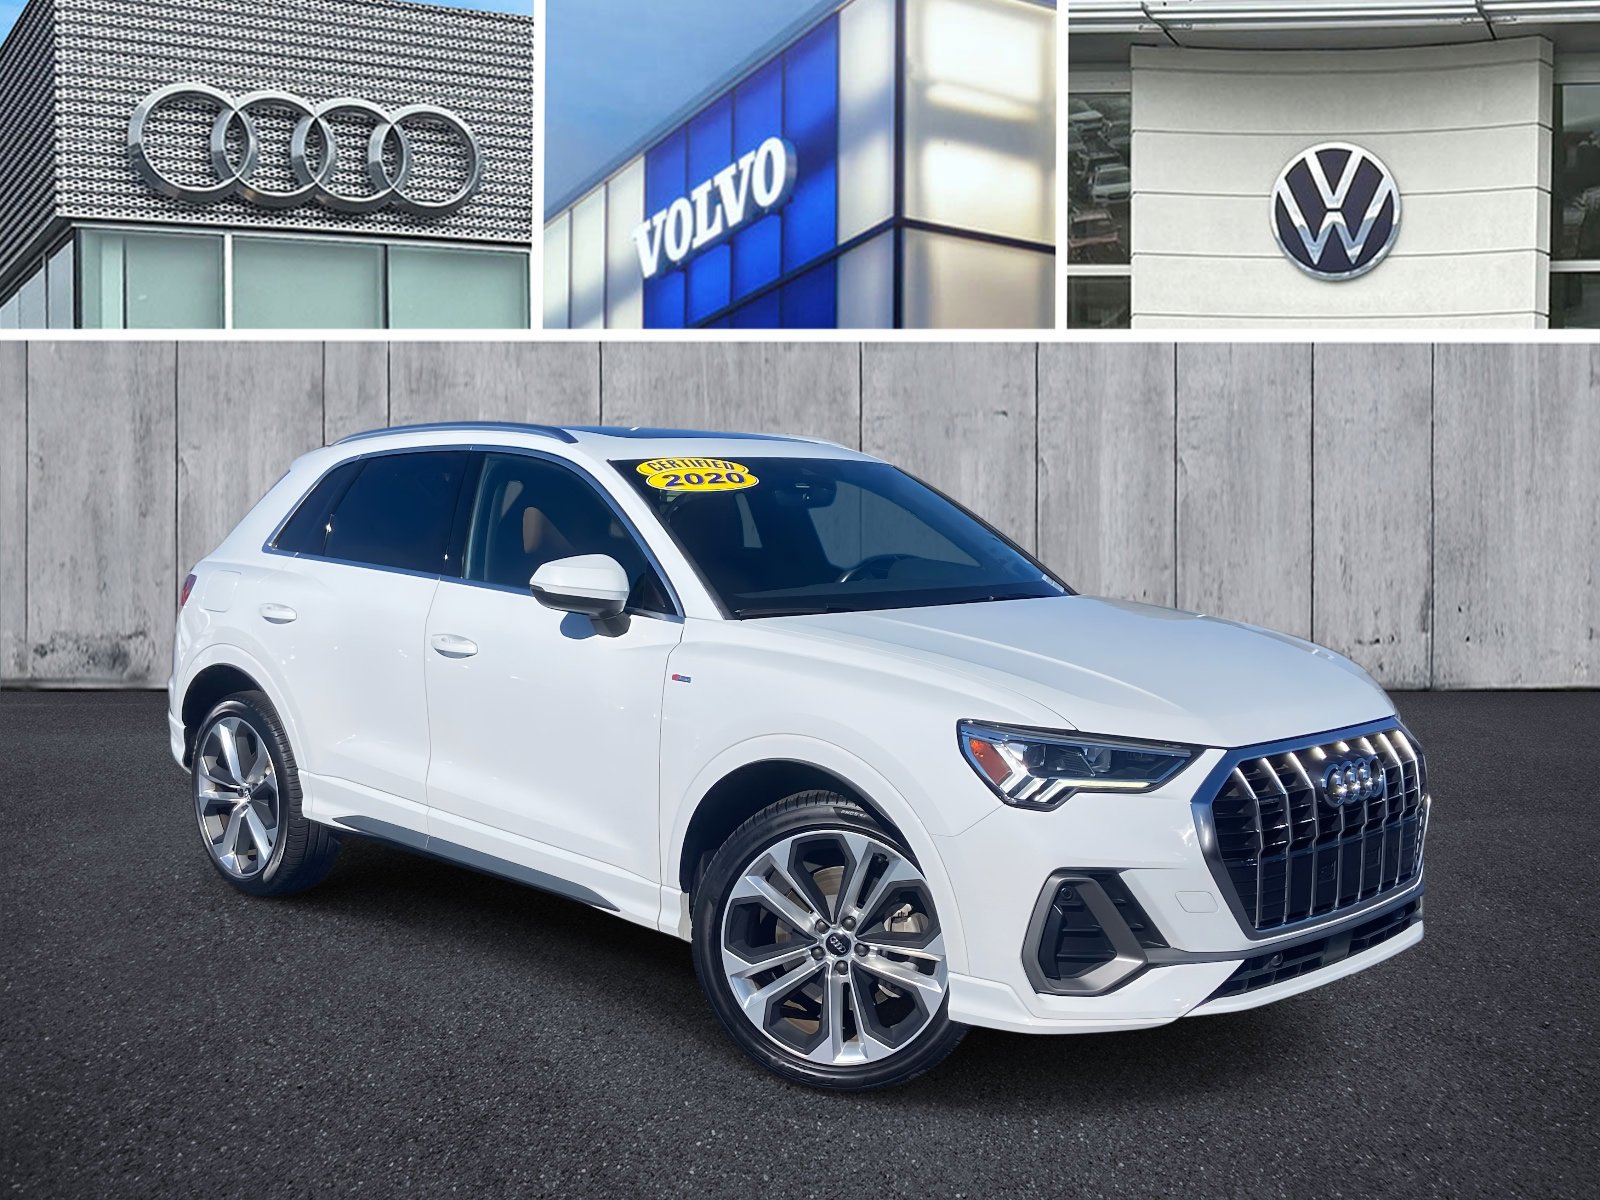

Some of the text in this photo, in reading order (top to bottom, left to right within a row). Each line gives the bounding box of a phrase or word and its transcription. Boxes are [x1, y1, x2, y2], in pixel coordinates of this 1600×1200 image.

[632, 136, 790, 279] VOLVO
[646, 459, 736, 471] CERTIFIED
[662, 472, 745, 487] 2020
